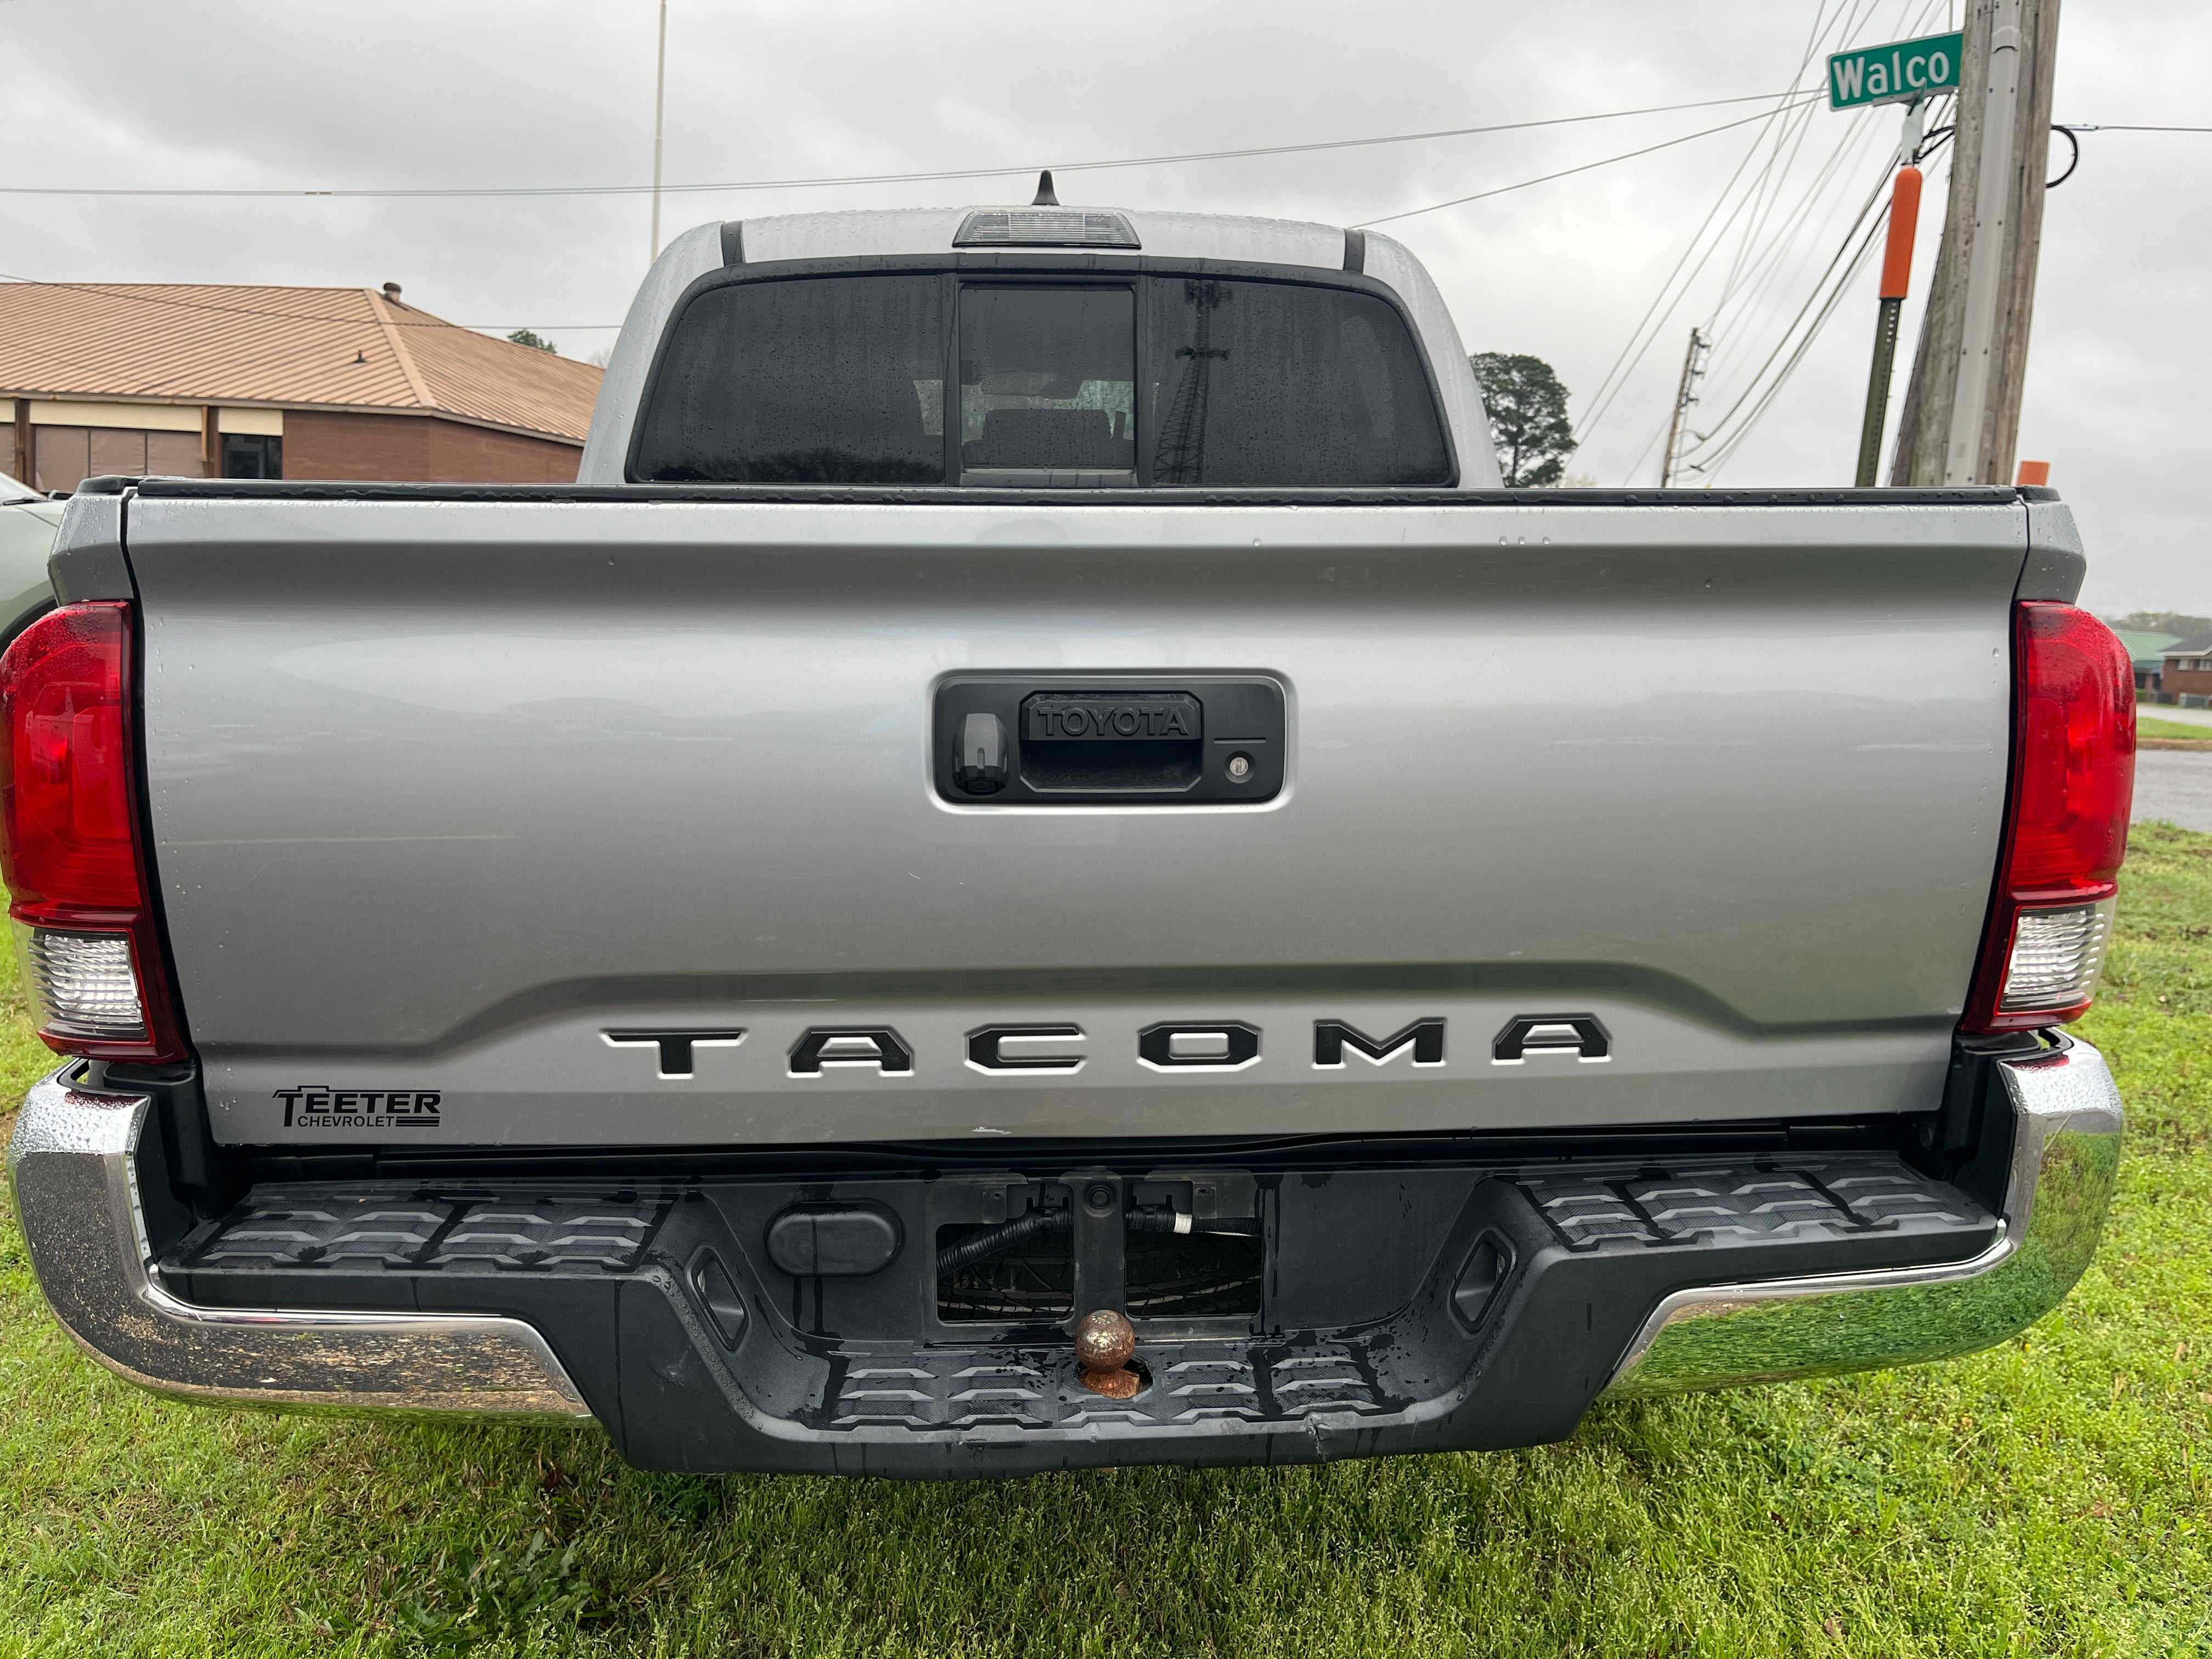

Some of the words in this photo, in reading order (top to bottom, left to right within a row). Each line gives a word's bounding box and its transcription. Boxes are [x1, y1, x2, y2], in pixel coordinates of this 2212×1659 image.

[1833, 50, 1950, 100] Walco
[1037, 707, 1189, 737] TOYOTA
[600, 1014, 1612, 1079] TACOMA
[277, 1093, 441, 1127] TEETER
[297, 1116, 394, 1127] CHEVROLET
